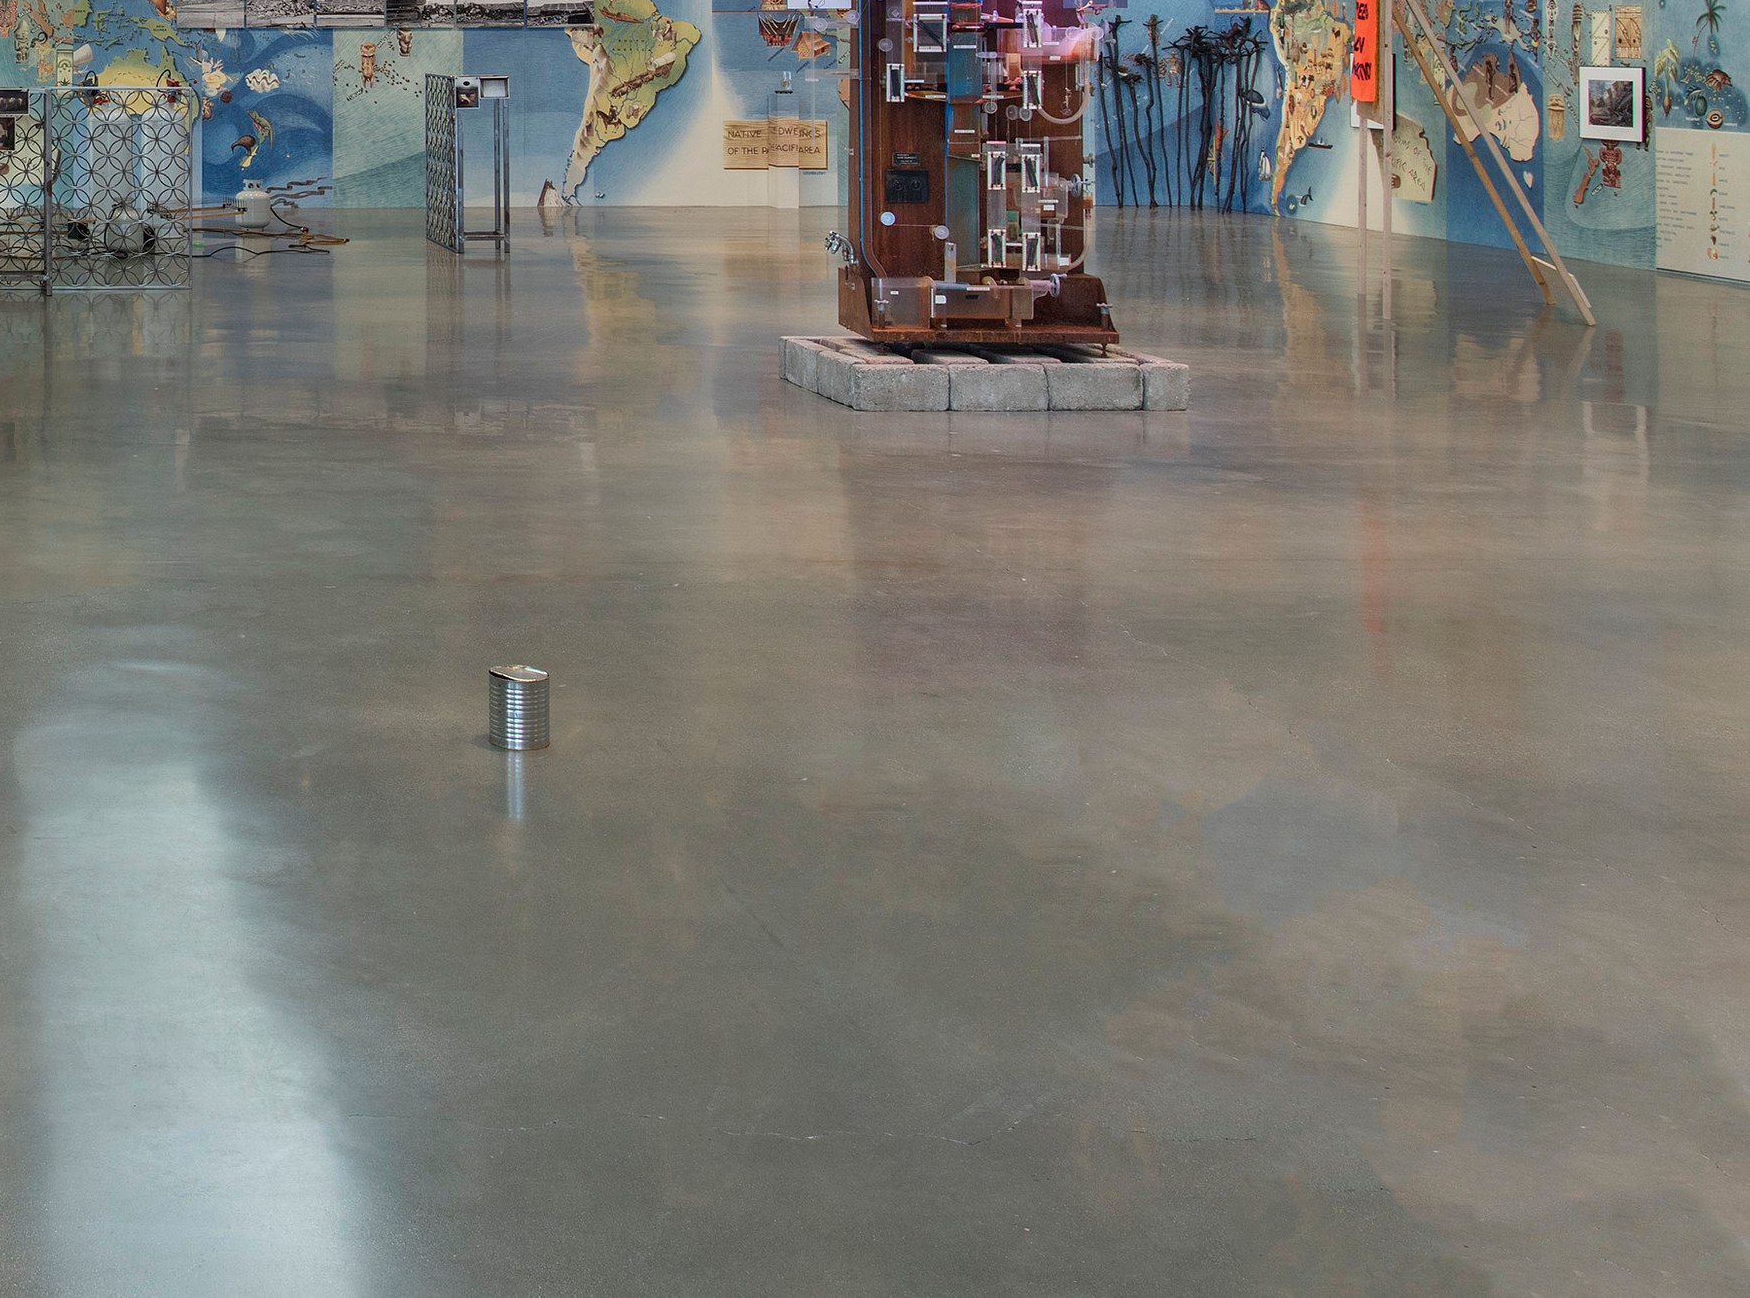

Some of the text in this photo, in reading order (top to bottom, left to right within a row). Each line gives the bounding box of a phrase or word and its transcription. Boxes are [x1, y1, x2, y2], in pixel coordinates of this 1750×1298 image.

[727, 129, 762, 138] NATIVE
[727, 147, 739, 155] OF
[741, 146, 758, 155] THE
